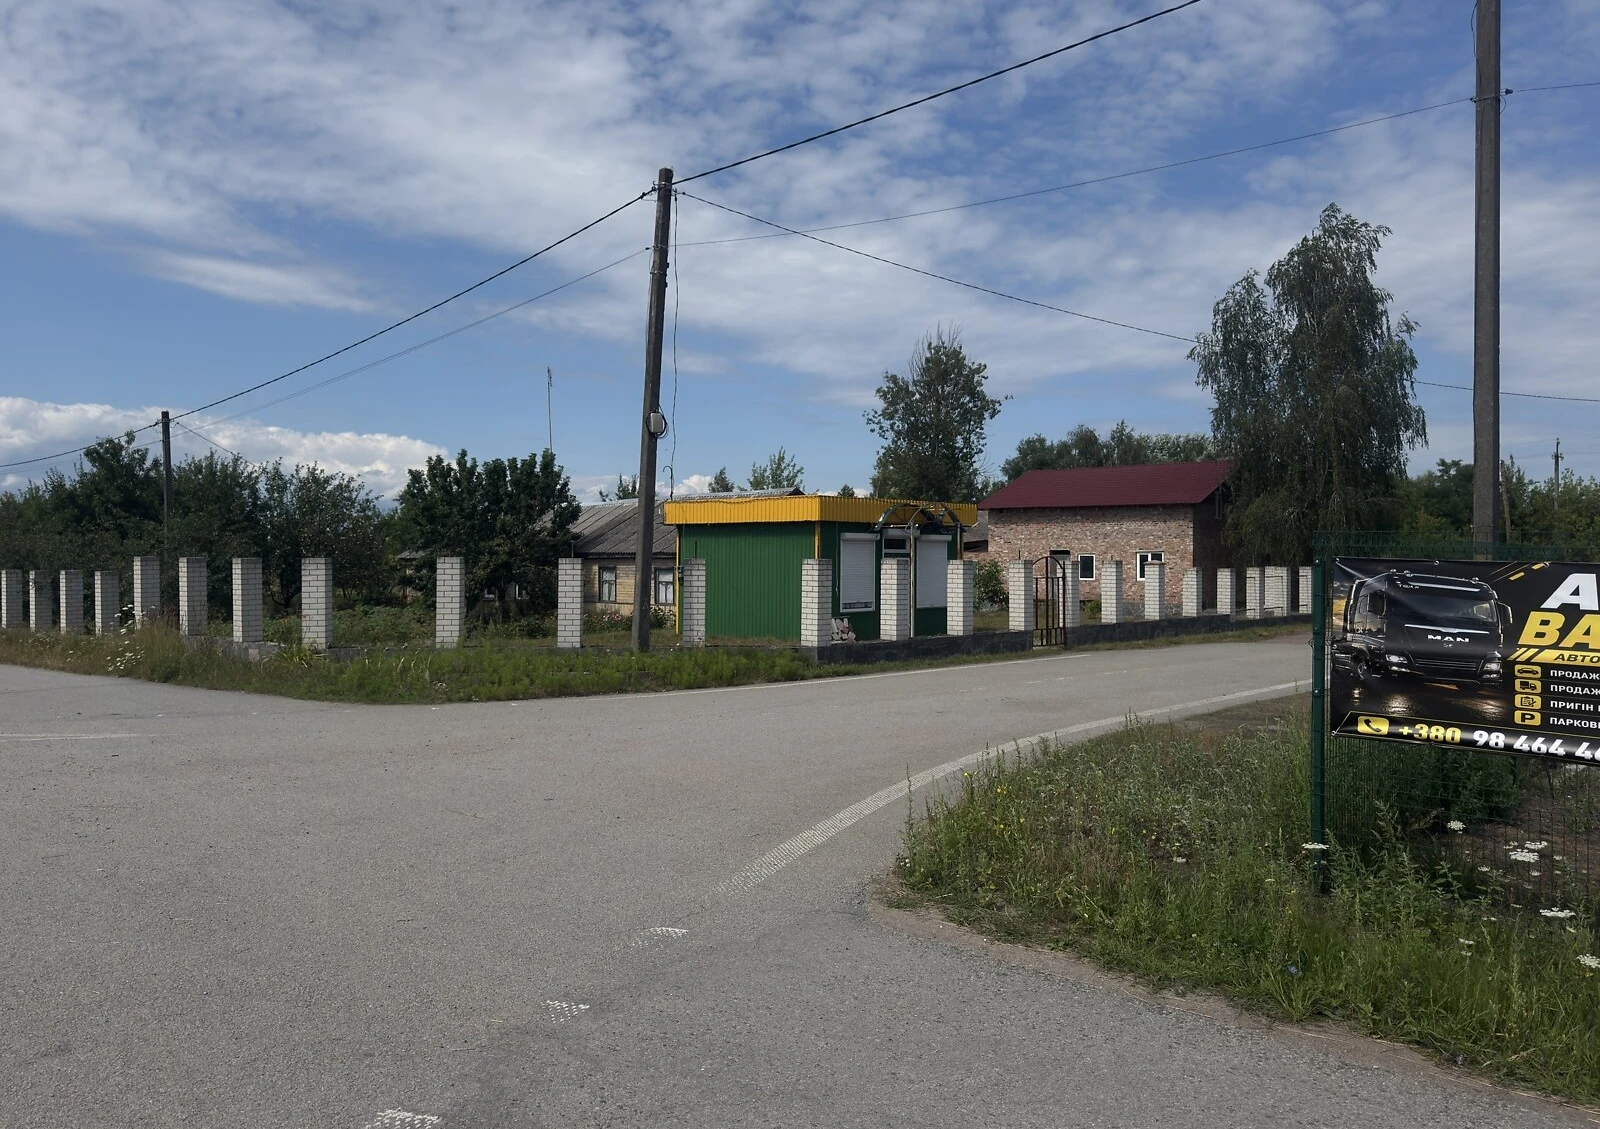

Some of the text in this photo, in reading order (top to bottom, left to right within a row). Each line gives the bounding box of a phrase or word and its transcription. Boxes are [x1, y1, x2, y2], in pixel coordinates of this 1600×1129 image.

[1427, 634, 1470, 643] MAN
[1554, 653, 1600, 663] АВТО
[1550, 669, 1600, 680] ПРОДАЖ
[1550, 684, 1600, 695] ПРОДАЖ
[1550, 700, 1594, 711] ПРИГІН
[1550, 717, 1600, 729] ПАРКОВ
[1398, 723, 1462, 744] +380
[1473, 730, 1506, 749] 98
[1513, 735, 1566, 756] 464
